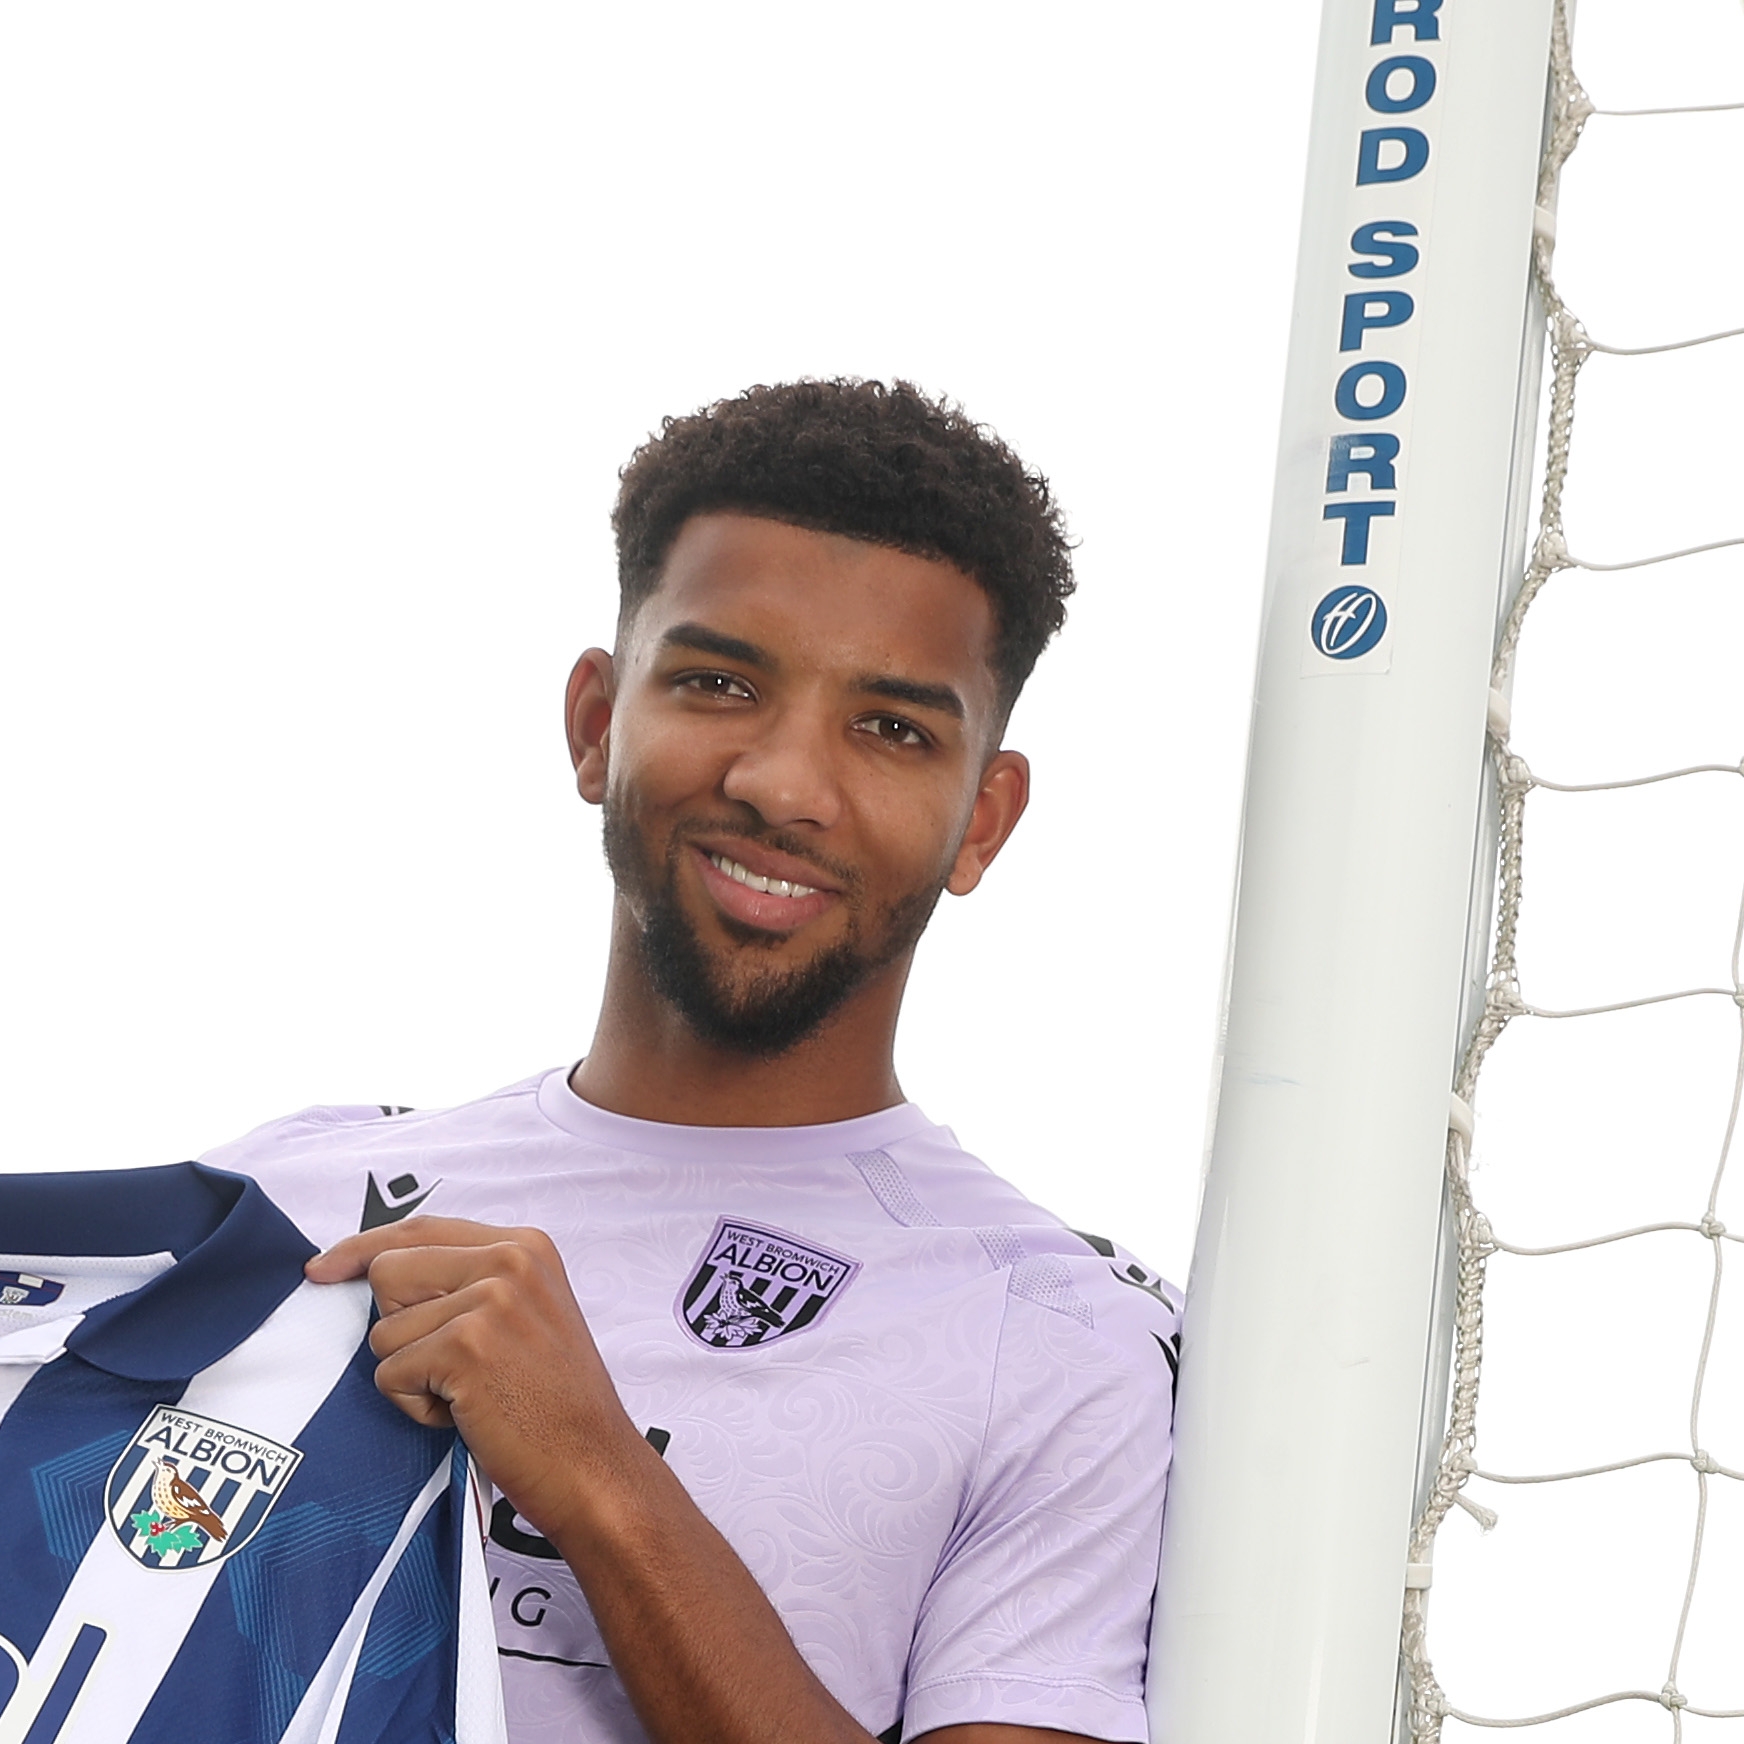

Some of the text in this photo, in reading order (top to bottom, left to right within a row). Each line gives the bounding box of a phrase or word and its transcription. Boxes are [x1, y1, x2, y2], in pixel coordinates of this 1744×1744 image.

[1322, 0, 1443, 567] ROD SPORT
[713, 1243, 835, 1292] ALBION
[726, 1230, 841, 1276] WEST BROMWICH
[144, 1425, 282, 1487] ALBION
[160, 1411, 289, 1465] WEST BROMWICH
